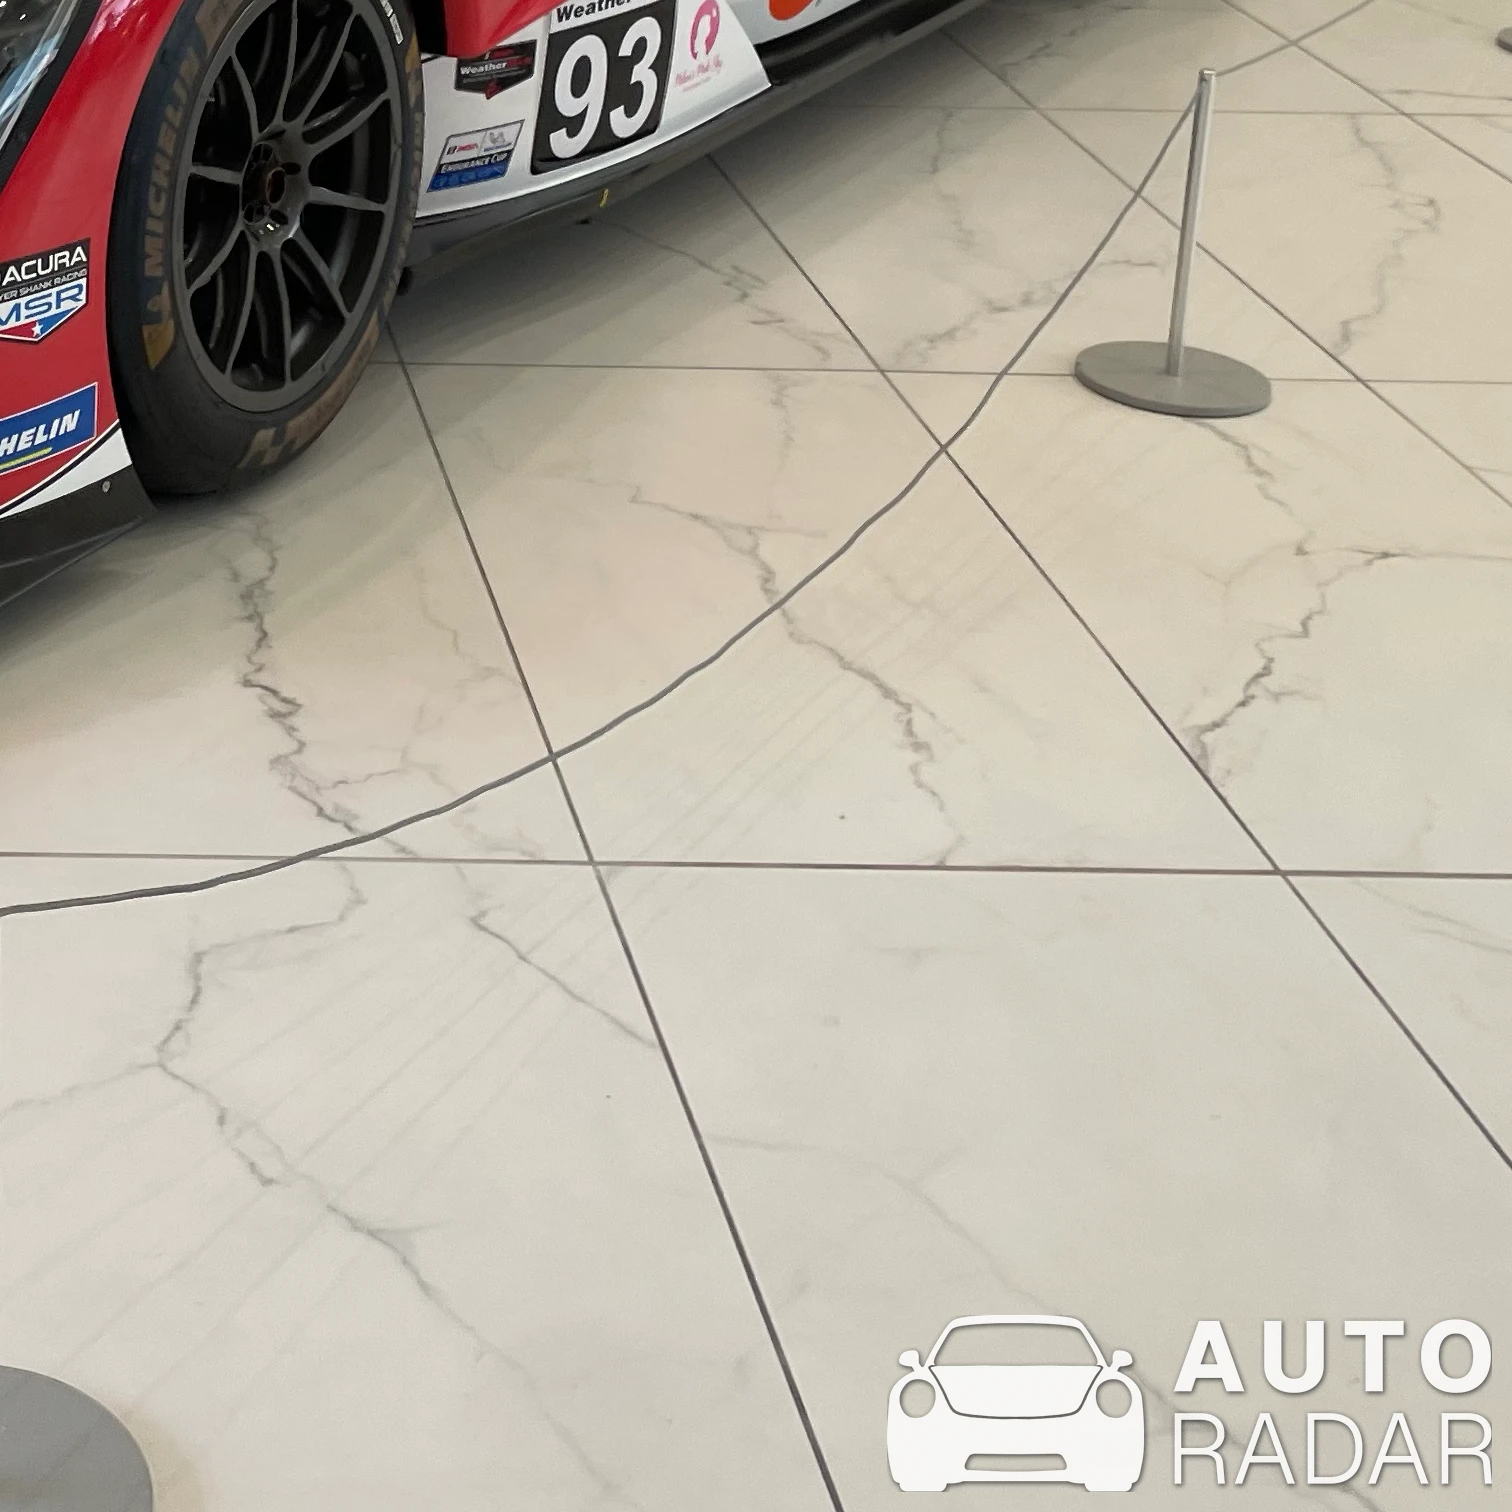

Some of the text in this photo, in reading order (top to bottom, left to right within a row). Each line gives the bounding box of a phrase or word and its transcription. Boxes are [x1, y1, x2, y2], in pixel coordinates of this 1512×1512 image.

[549, 17, 662, 159] 93
[143, 47, 200, 277] MICHELIN
[2, 246, 87, 286] ACURA
[19, 280, 52, 296] SHANK
[54, 268, 87, 284] RACING
